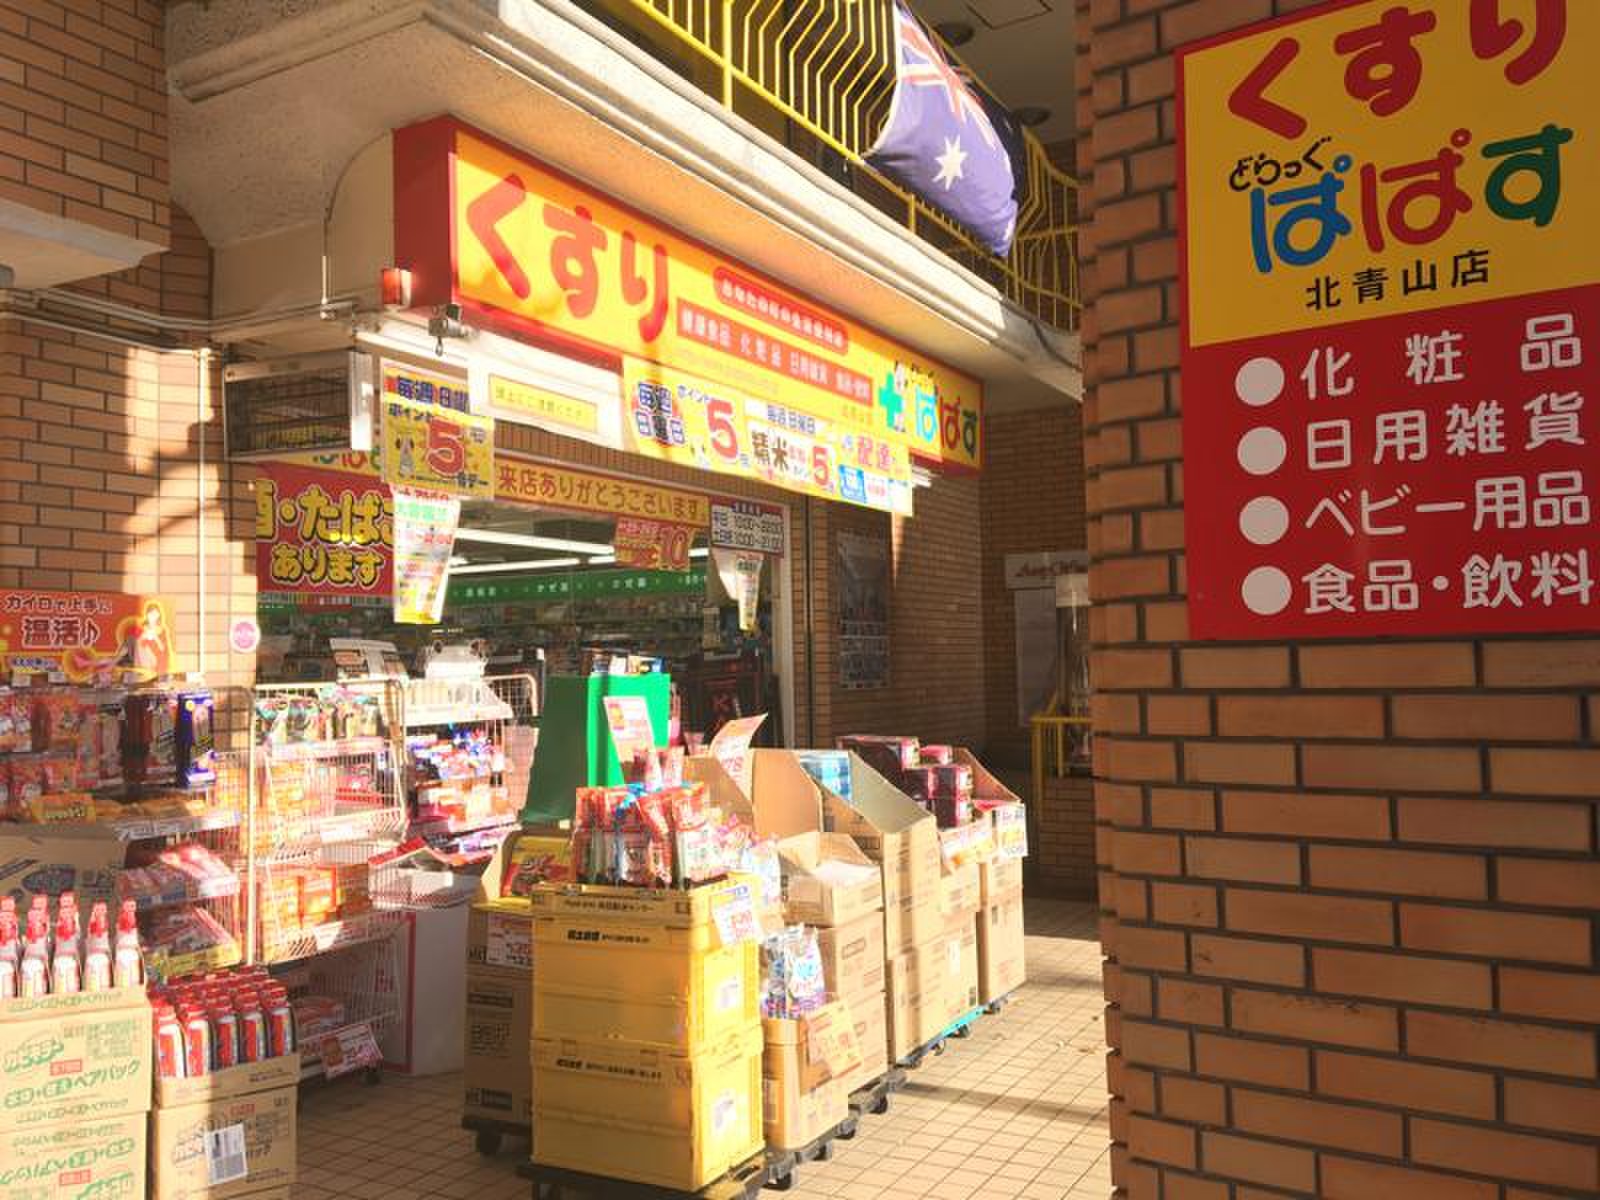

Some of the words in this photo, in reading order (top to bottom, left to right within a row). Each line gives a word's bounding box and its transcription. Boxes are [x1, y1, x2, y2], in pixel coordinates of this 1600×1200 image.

[1228, 0, 1567, 140] くすり
[1229, 136, 1332, 192] どらっぐ
[1250, 123, 1573, 273] ぱぱす
[466, 173, 669, 343] くすり
[1305, 249, 1490, 310] 北青山店
[1301, 313, 1582, 400] 化粧品
[427, 416, 465, 480] 5
[706, 399, 738, 460] 5
[1306, 391, 1585, 471] 日用雑貨
[811, 444, 830, 487] 5
[1303, 470, 1591, 536] ベビー用品
[272, 543, 384, 590] あります
[1302, 549, 1595, 614] 食品・飲料
